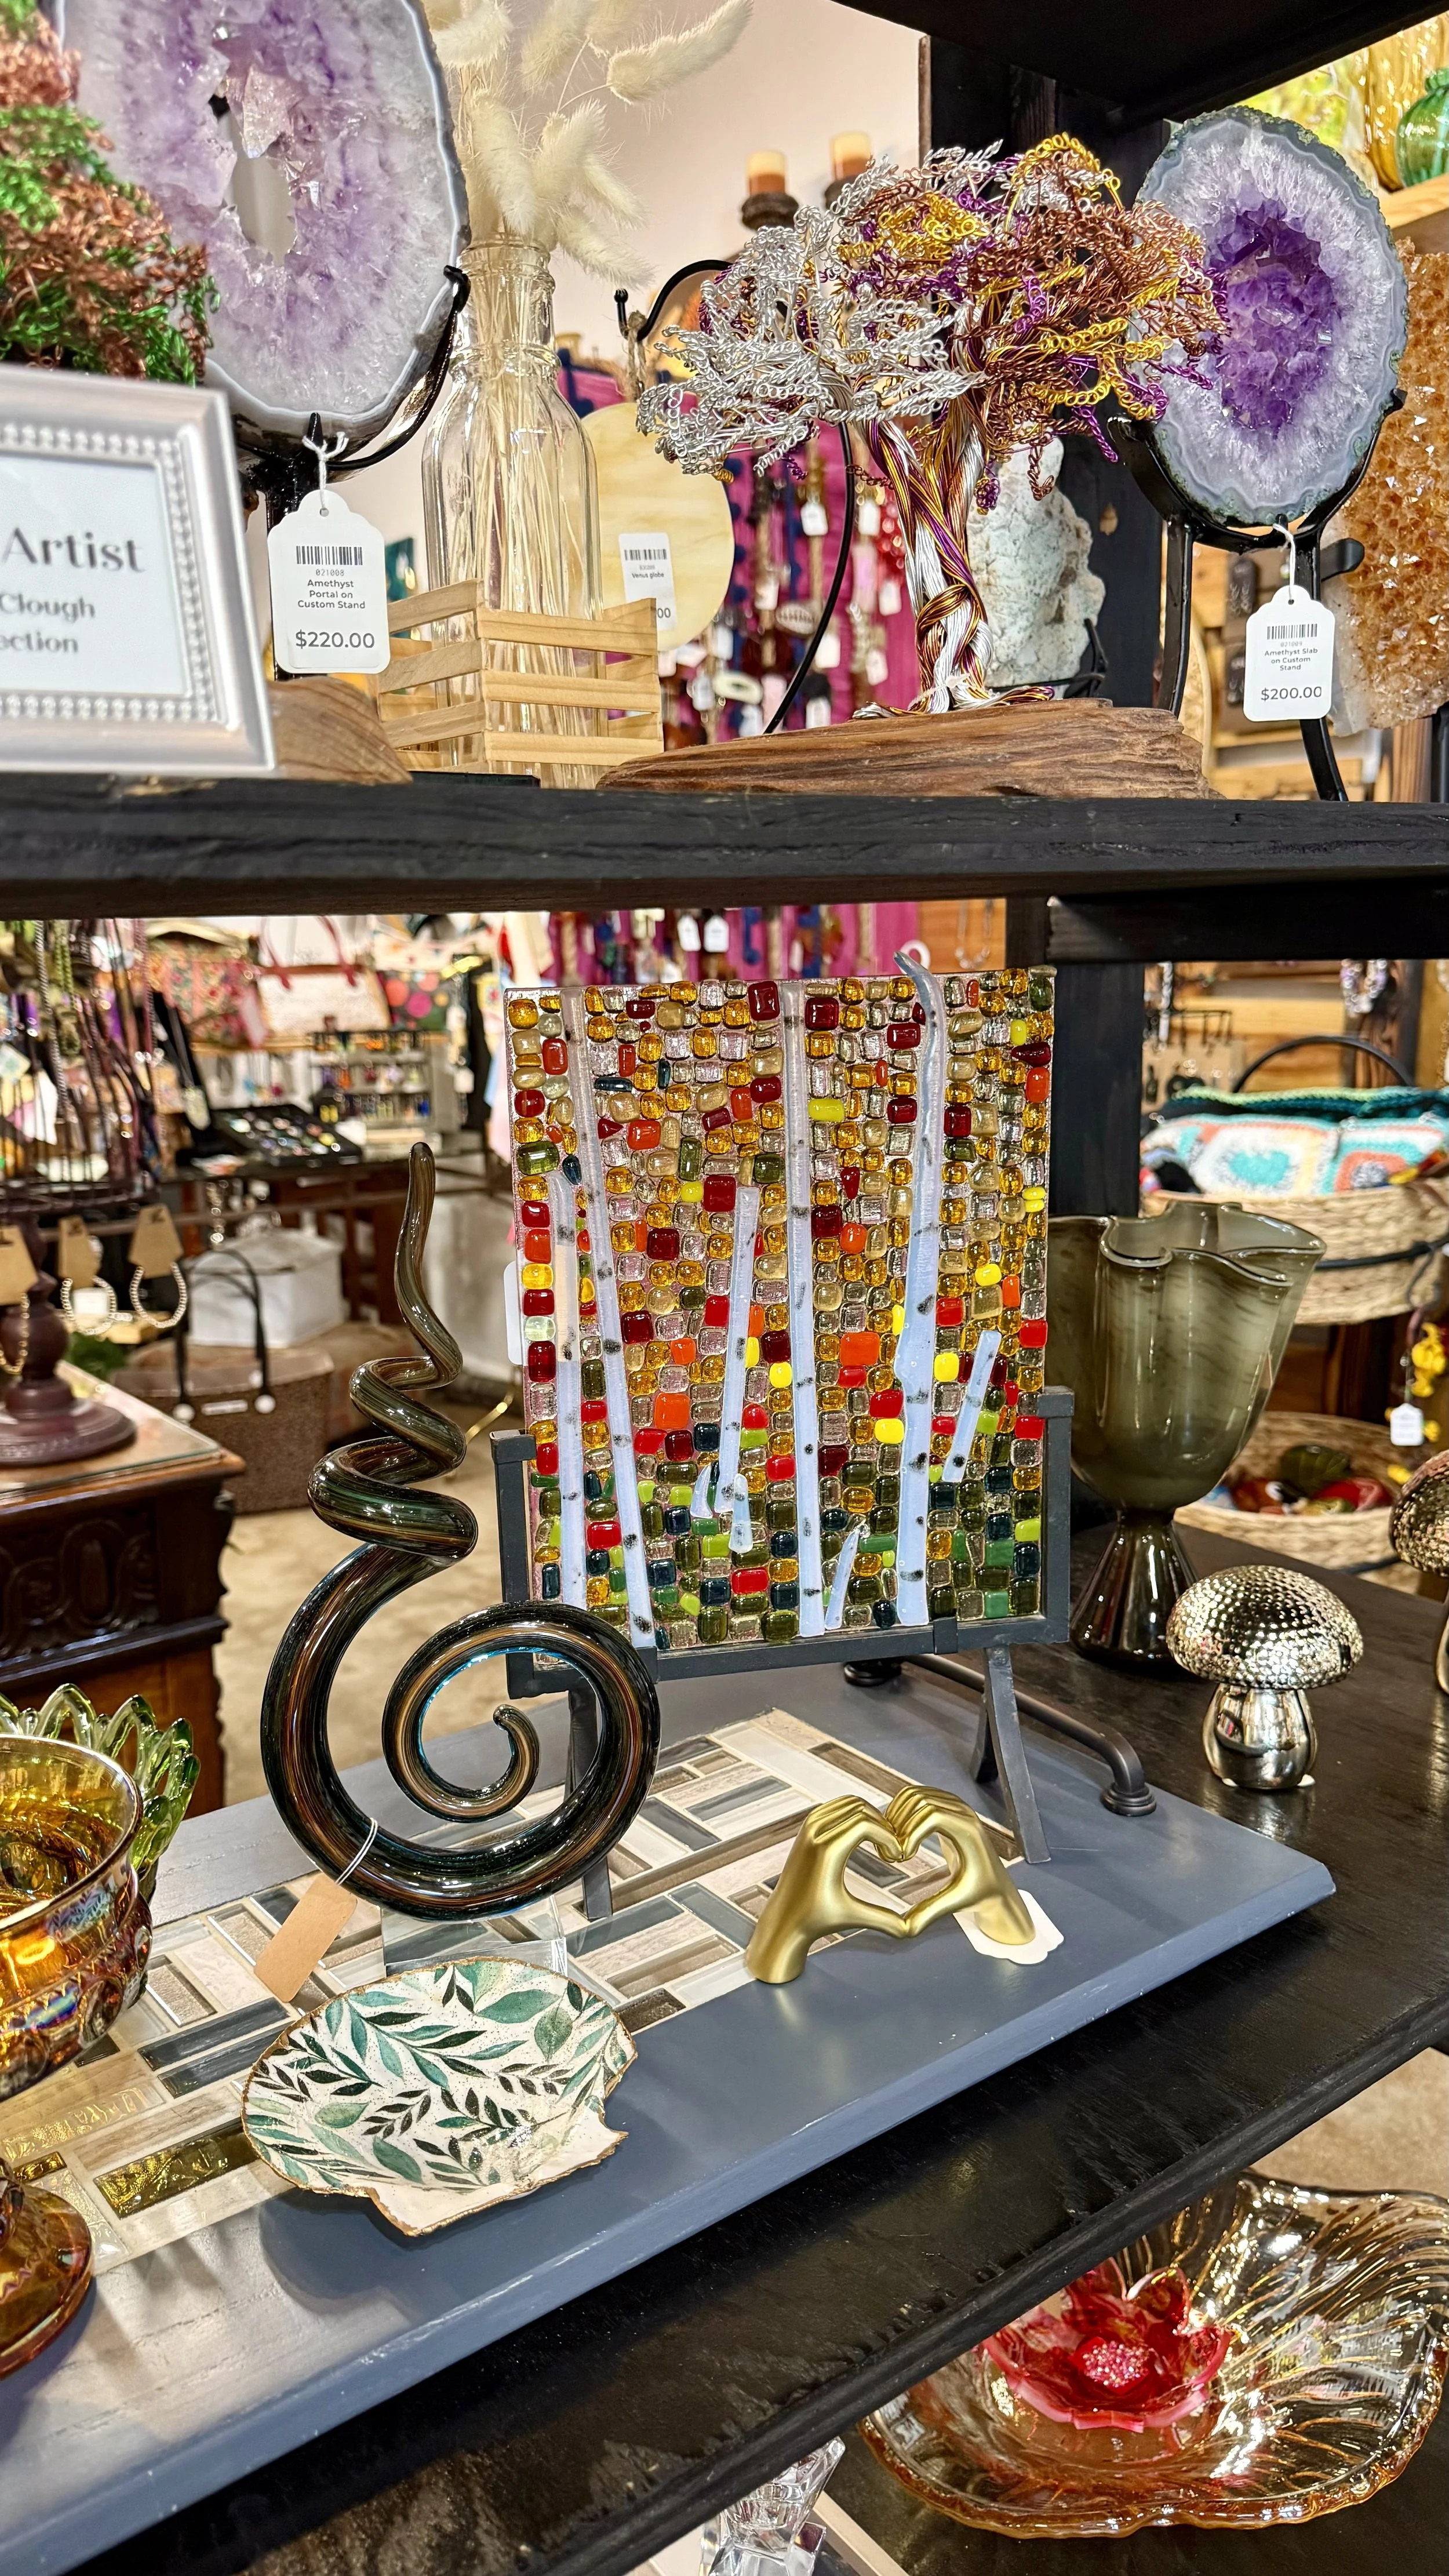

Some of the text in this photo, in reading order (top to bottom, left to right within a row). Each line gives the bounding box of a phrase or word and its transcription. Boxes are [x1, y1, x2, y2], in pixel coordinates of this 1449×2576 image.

[2, 527, 146, 573] Artist
[307, 579, 354, 589] Amethyst
[309, 590, 338, 598] Portal
[0, 593, 96, 624] Clough
[297, 600, 366, 609] Custom Stand
[296, 629, 375, 649] $220.00
[1264, 649, 1300, 657] Amethyst
[1261, 686, 1321, 701] $200.00
